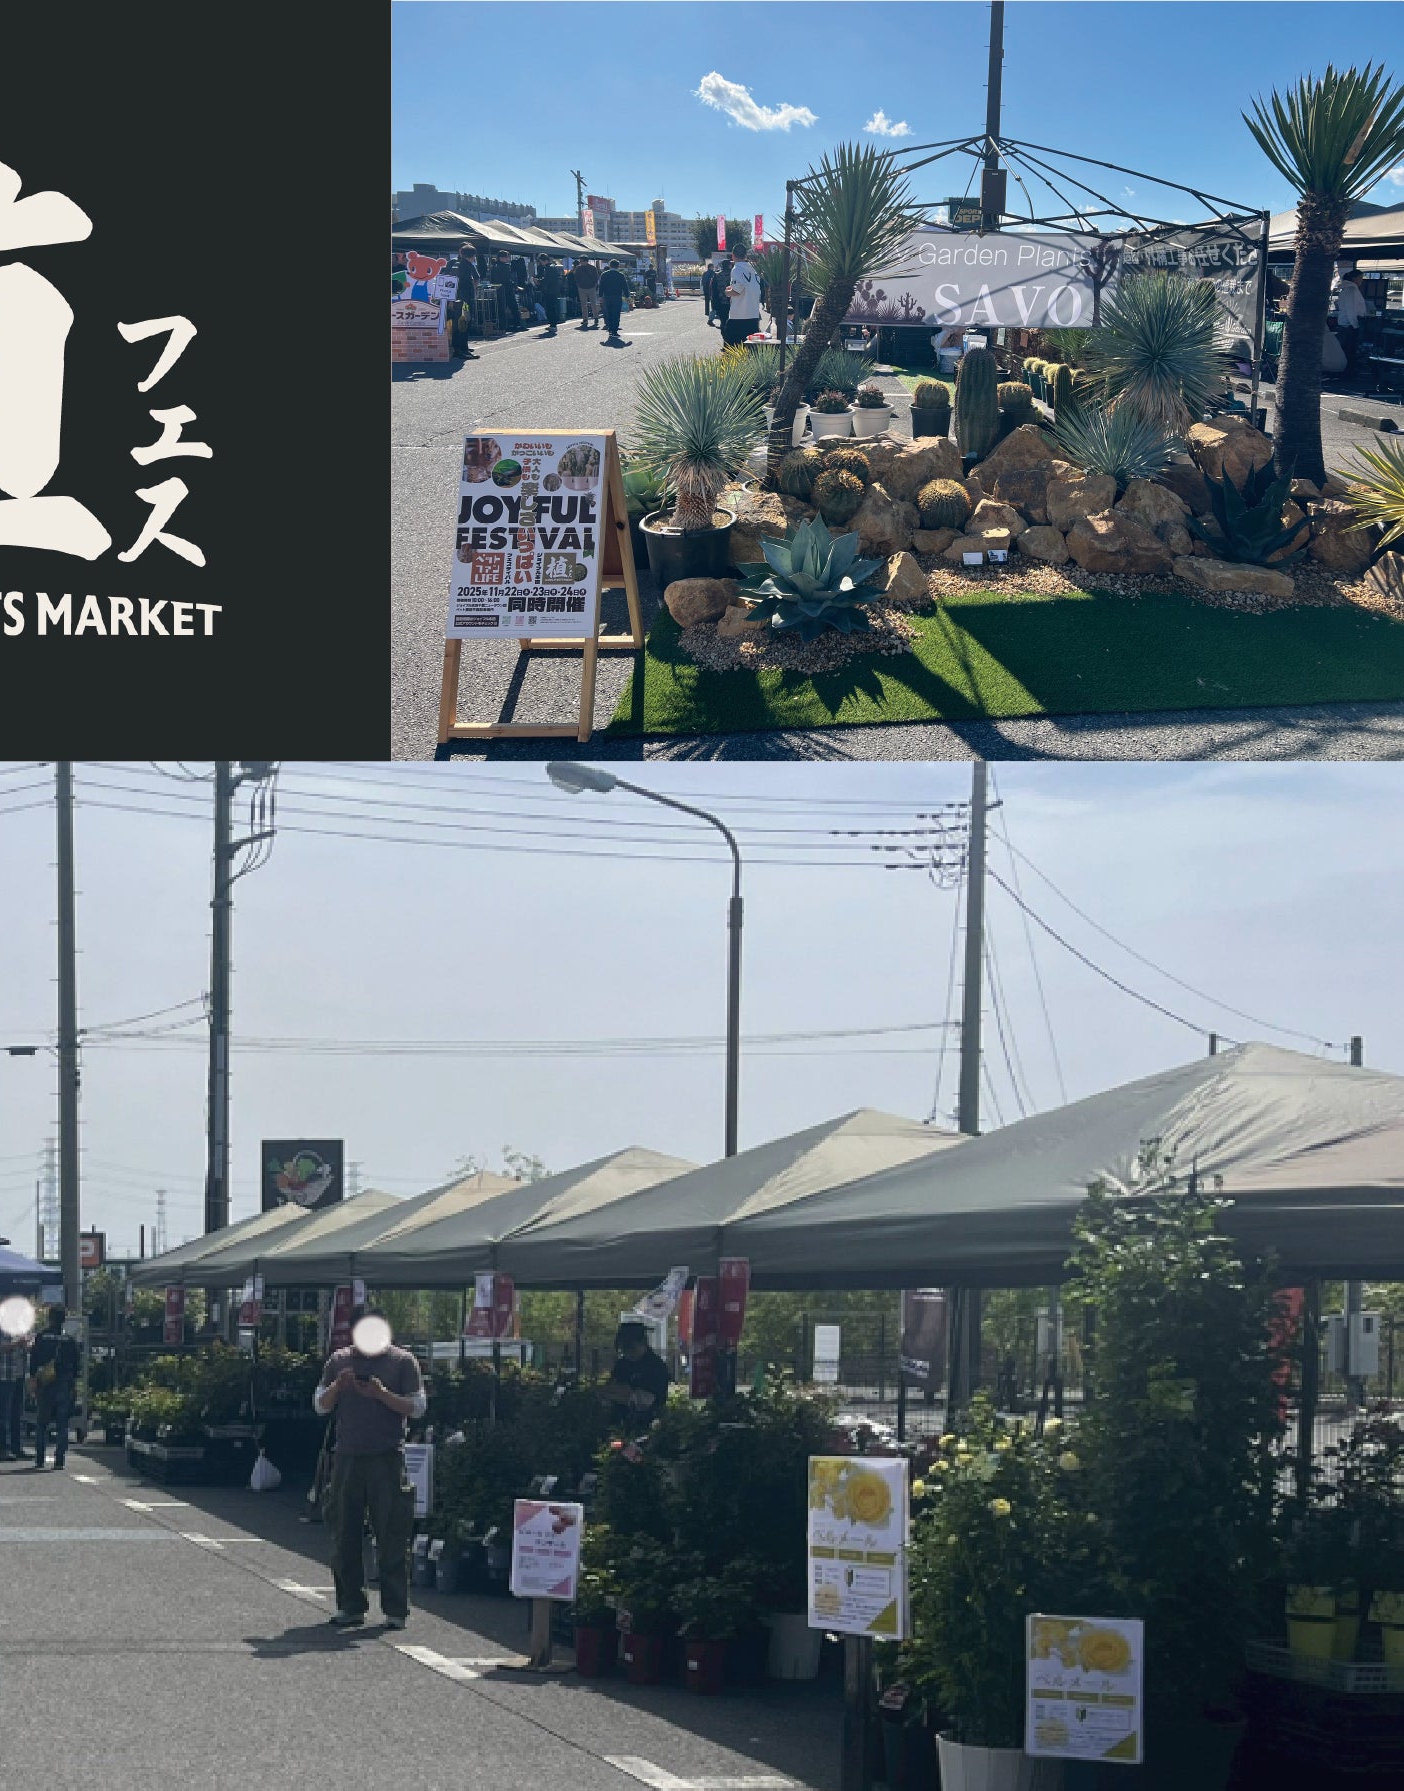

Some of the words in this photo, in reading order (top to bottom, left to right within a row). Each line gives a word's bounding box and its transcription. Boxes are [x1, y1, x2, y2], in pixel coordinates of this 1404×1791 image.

[918, 242, 1007, 266] Garden
[1017, 245, 1091, 267] Plants
[933, 283, 1082, 327] SAVO
[532, 458, 541, 481] 大人も
[457, 495, 596, 524] JOYFUL
[455, 526, 595, 550] FESTVAL
[474, 573, 500, 583] LIFE
[507, 597, 586, 613] 同時開催
